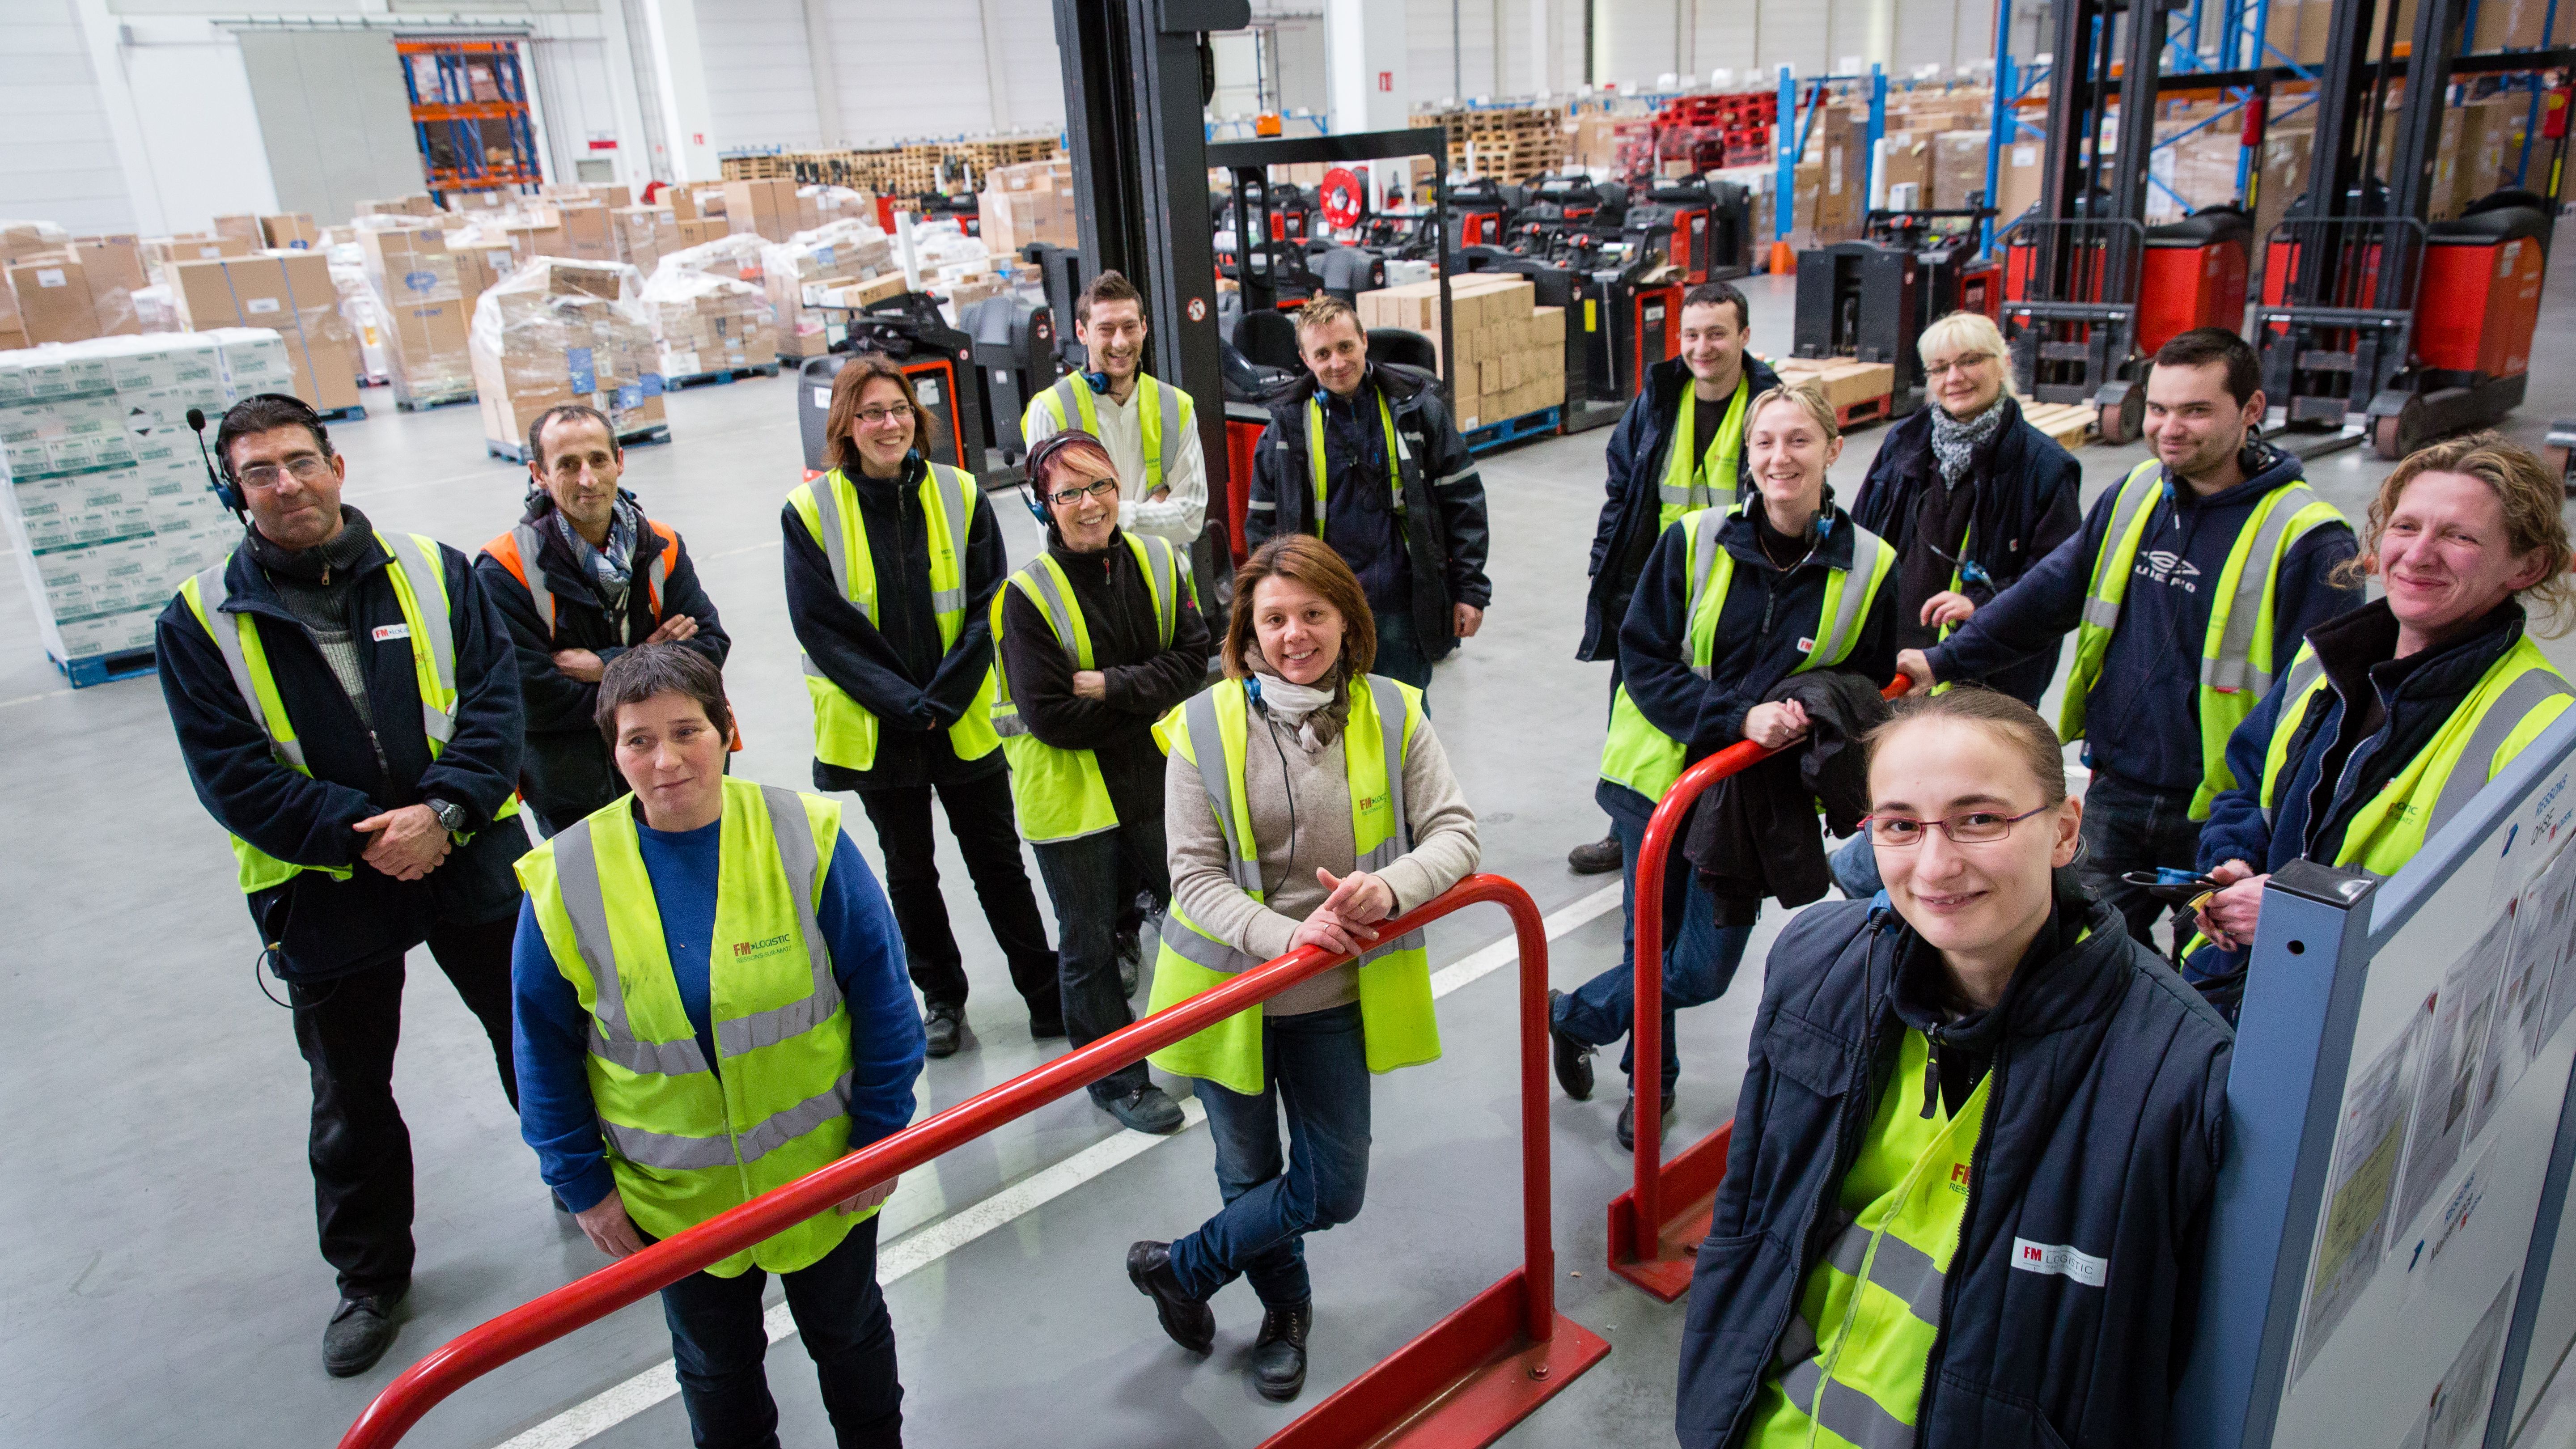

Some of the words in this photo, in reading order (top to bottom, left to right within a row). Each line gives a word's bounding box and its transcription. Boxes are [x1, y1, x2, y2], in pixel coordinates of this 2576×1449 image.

[376, 629, 389, 638] FM
[1360, 797, 1372, 810] FM
[2531, 808, 2555, 845] QHSE
[733, 942, 751, 957] FM
[755, 934, 790, 949] LOGISTIC
[737, 945, 791, 963] RESSONS-SUR-MATZ
[2024, 1246, 2042, 1262] FM
[2046, 1254, 2093, 1275] LOGISTIC
